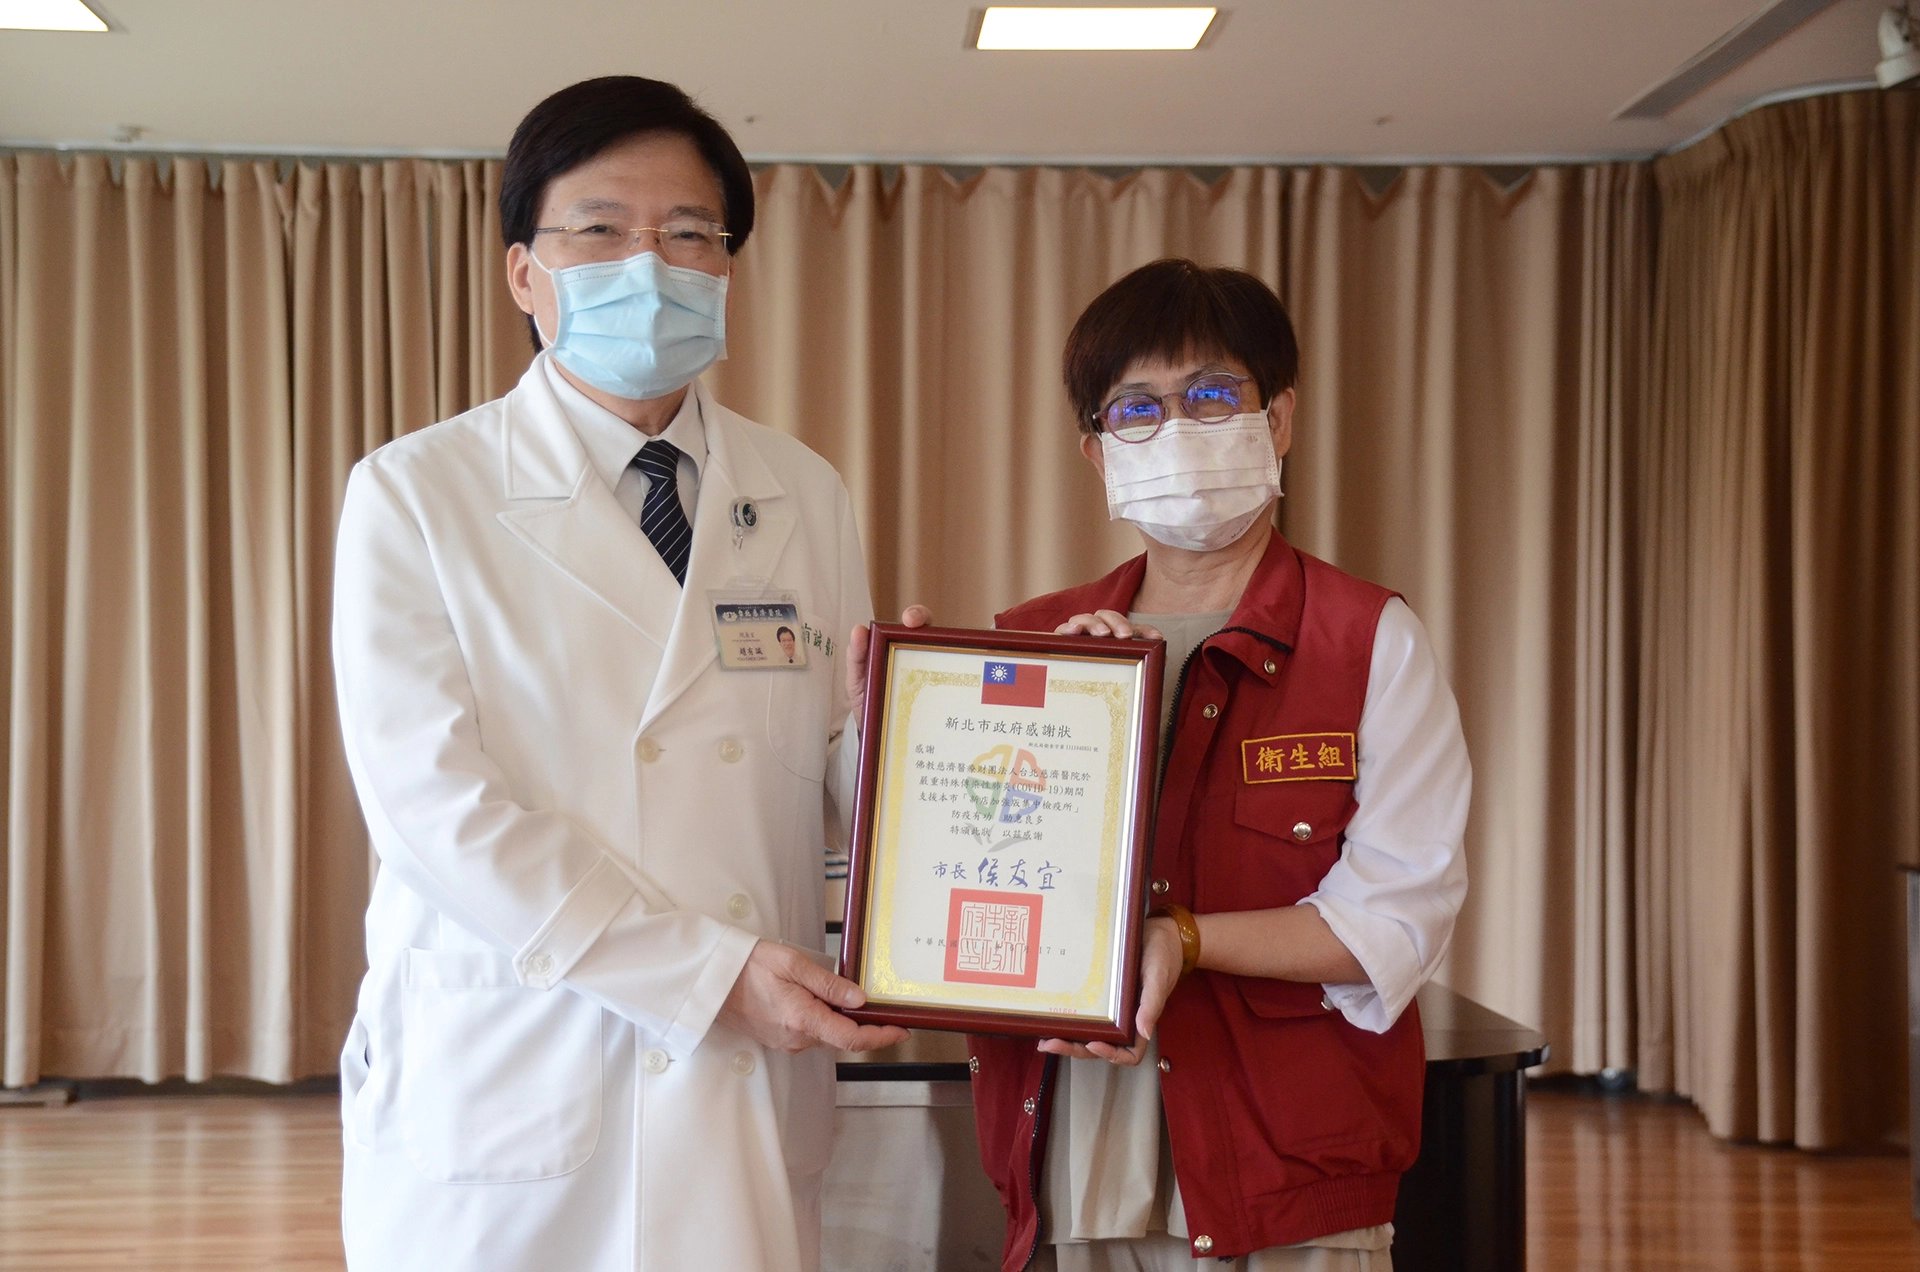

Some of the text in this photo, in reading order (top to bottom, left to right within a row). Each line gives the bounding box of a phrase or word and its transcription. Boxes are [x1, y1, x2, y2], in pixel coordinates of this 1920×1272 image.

[945, 716, 1072, 739] 新北市政府感謝狀
[915, 744, 936, 754] 感謝
[1256, 742, 1345, 773] 衛生組
[933, 857, 1062, 890] 市長 侯友宜
